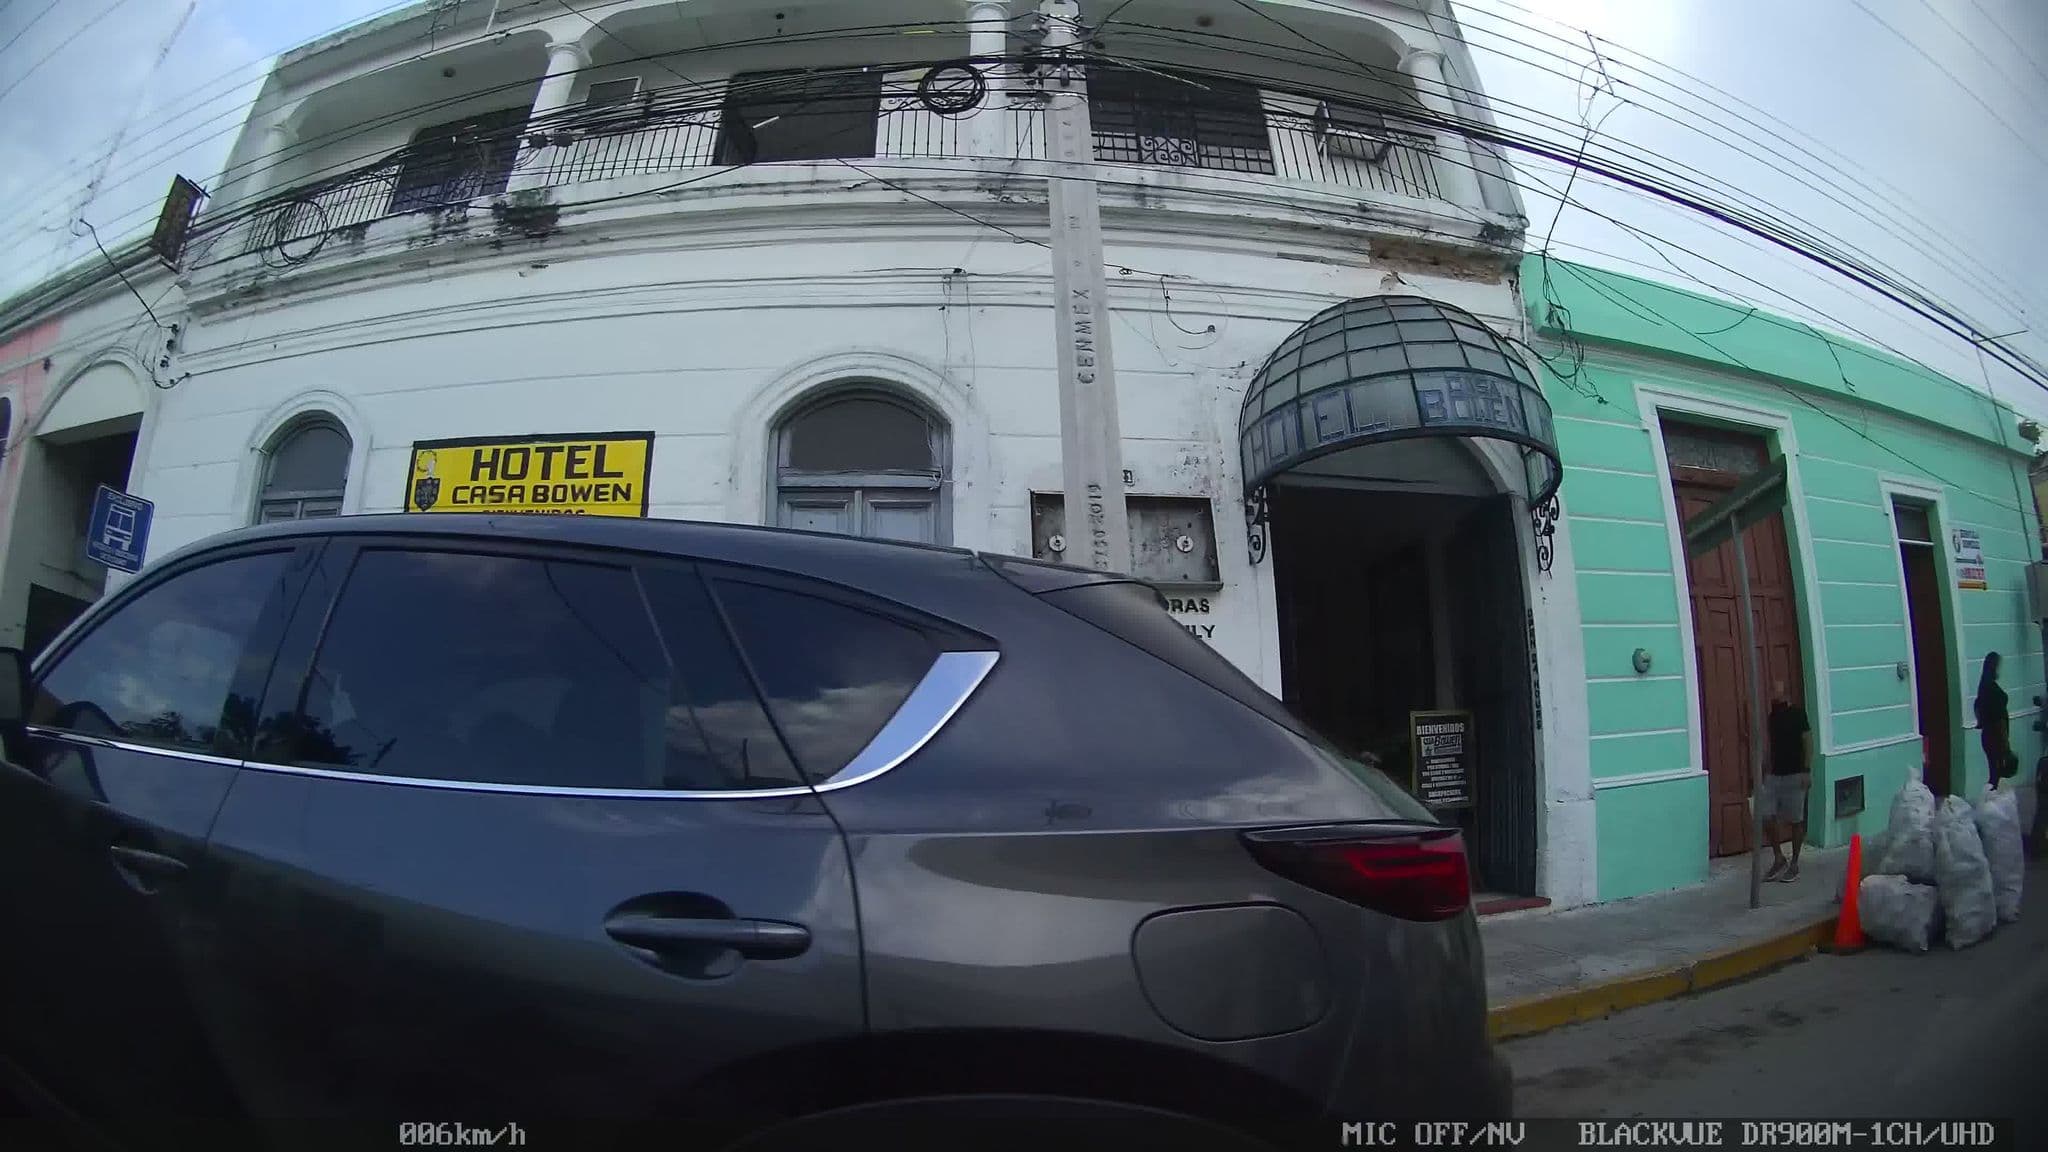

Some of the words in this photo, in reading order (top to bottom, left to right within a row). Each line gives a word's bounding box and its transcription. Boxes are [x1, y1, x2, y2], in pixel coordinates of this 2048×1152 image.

[470, 444, 624, 482] HOTEL
[452, 485, 525, 505] CASA
[531, 483, 632, 504] BOWEN
